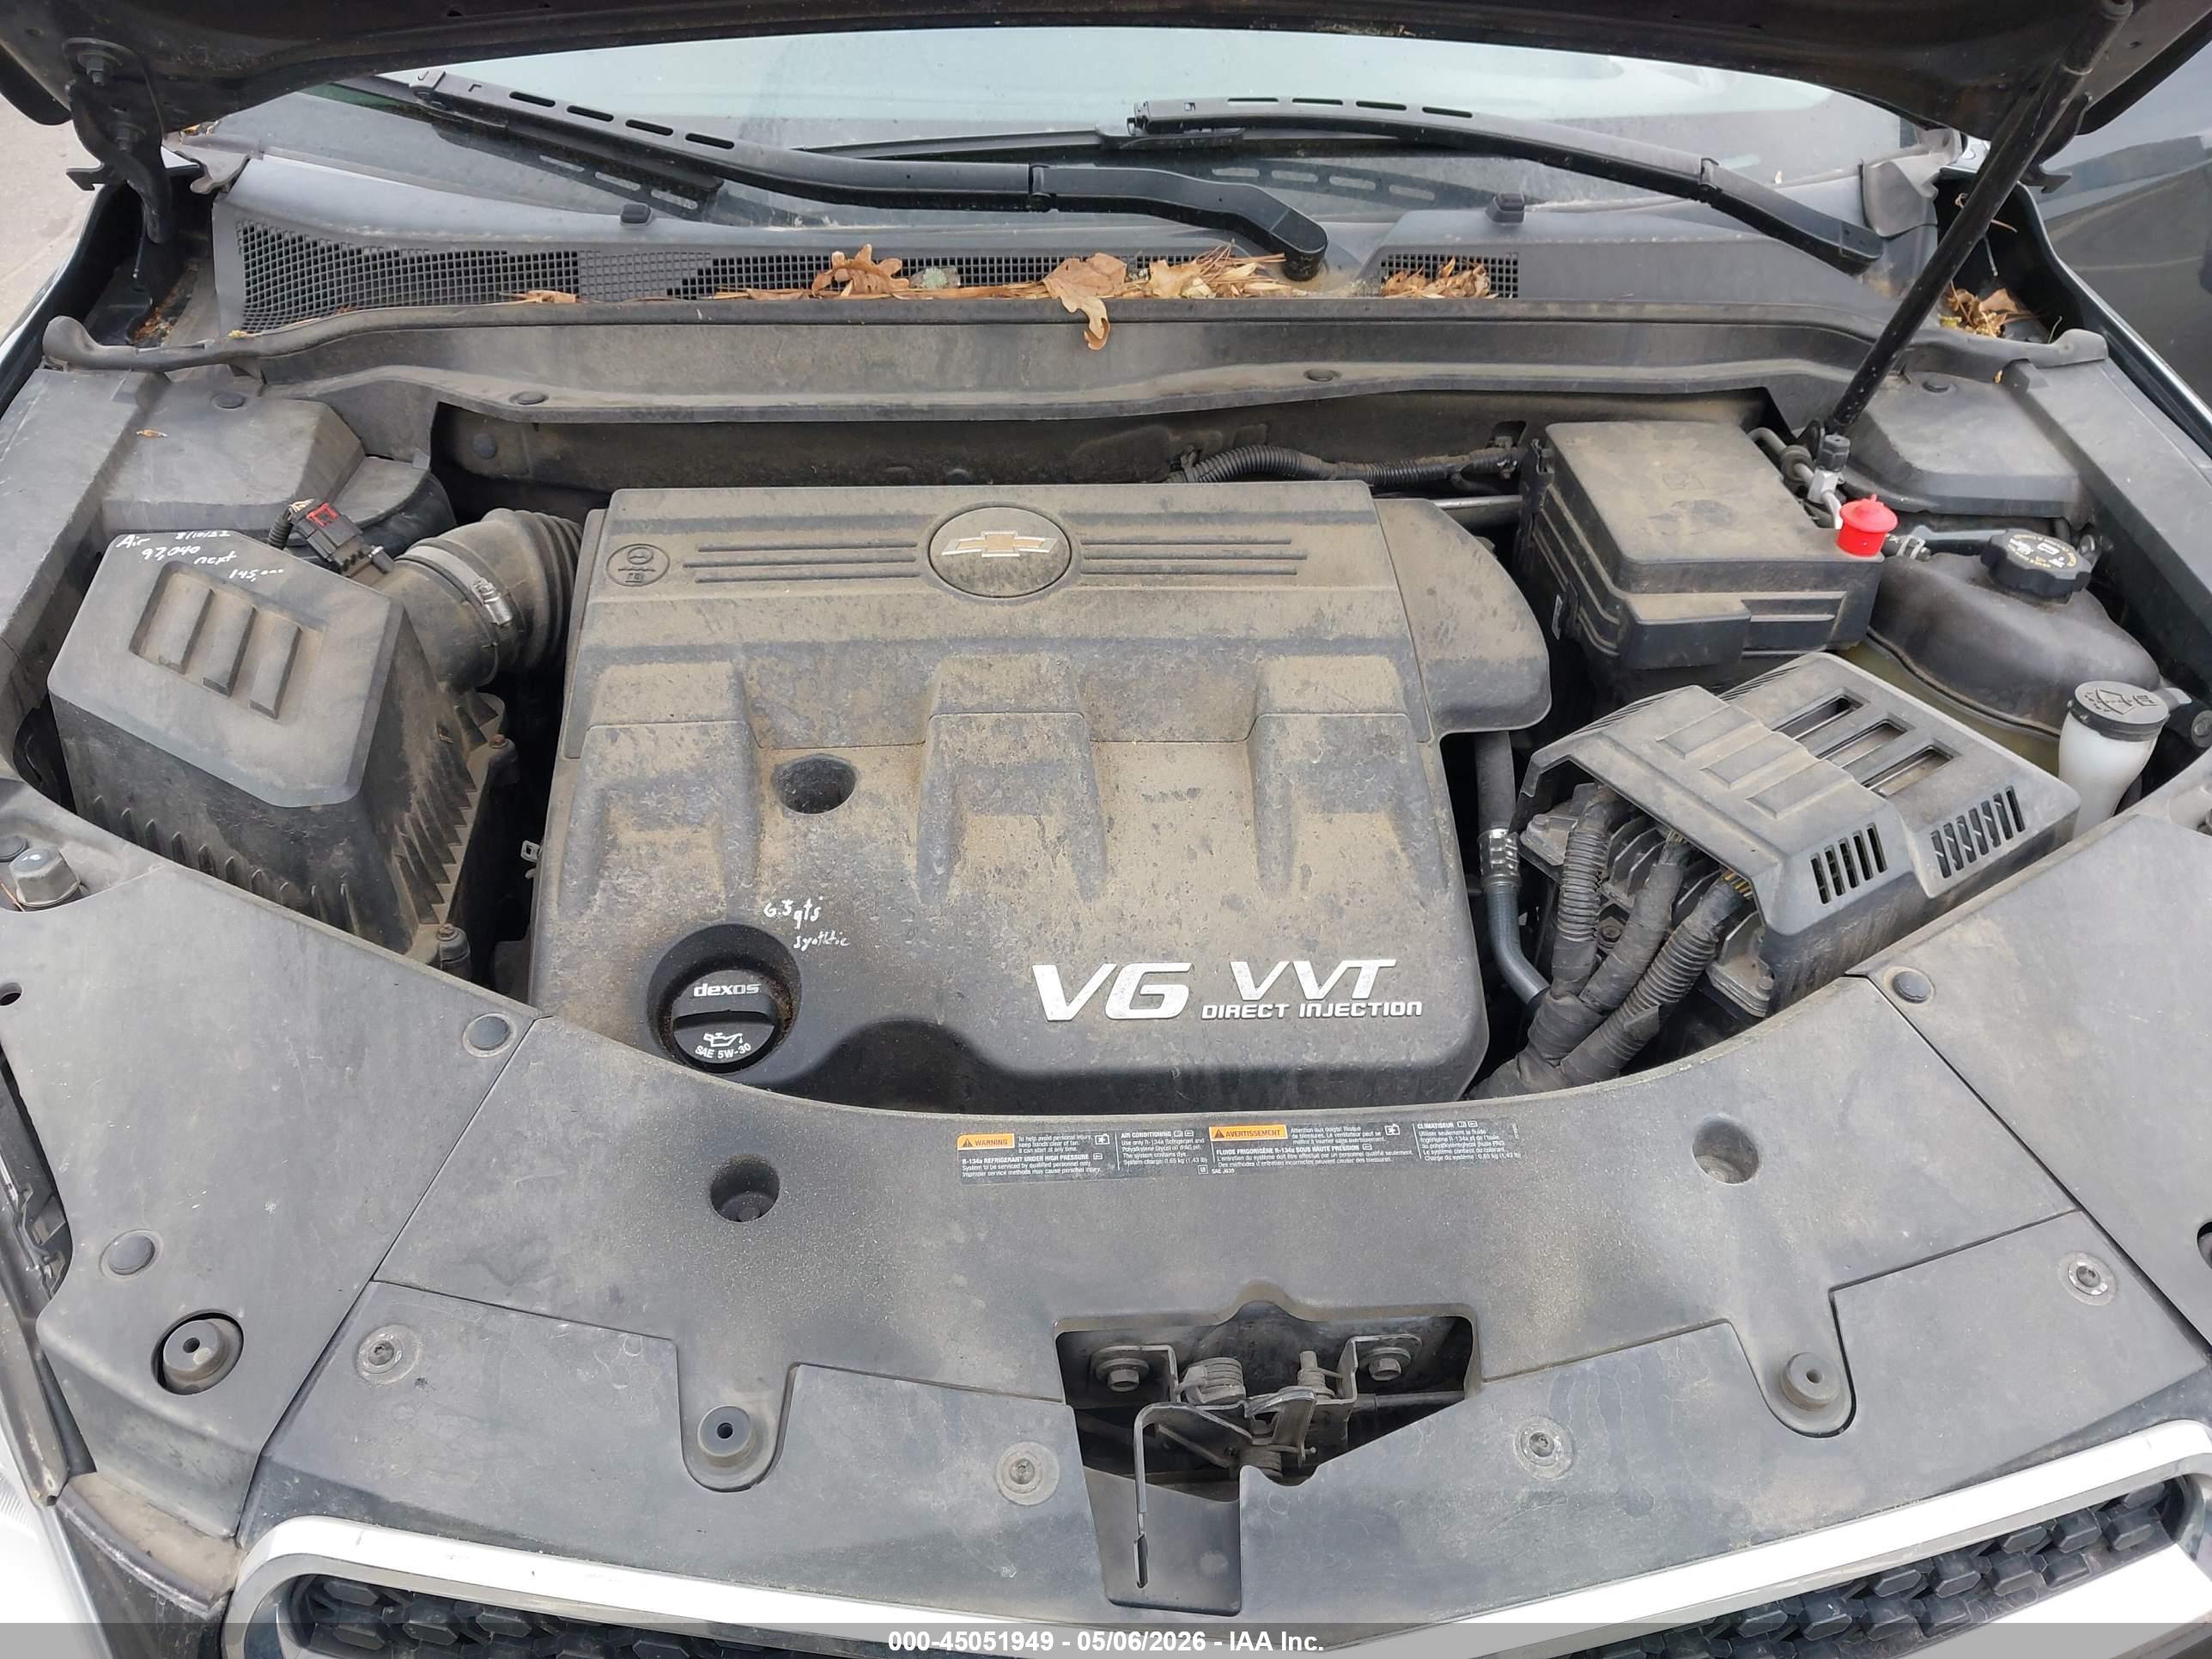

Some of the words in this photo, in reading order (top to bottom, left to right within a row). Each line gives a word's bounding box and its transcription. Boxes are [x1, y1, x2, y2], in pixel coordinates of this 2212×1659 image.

[116, 534, 150, 549] Air
[194, 550, 237, 565] next
[693, 982, 763, 997] dexos
[1031, 962, 1194, 1022] V6
[1230, 959, 1396, 1000] VVT
[1202, 1003, 1290, 1019] DIRECT
[1298, 1000, 1422, 1018] INJECTION
[695, 1044, 715, 1059] SAE
[717, 1042, 751, 1060] 5W-30
[1225, 1129, 1280, 1138] AVERTISSEMENT
